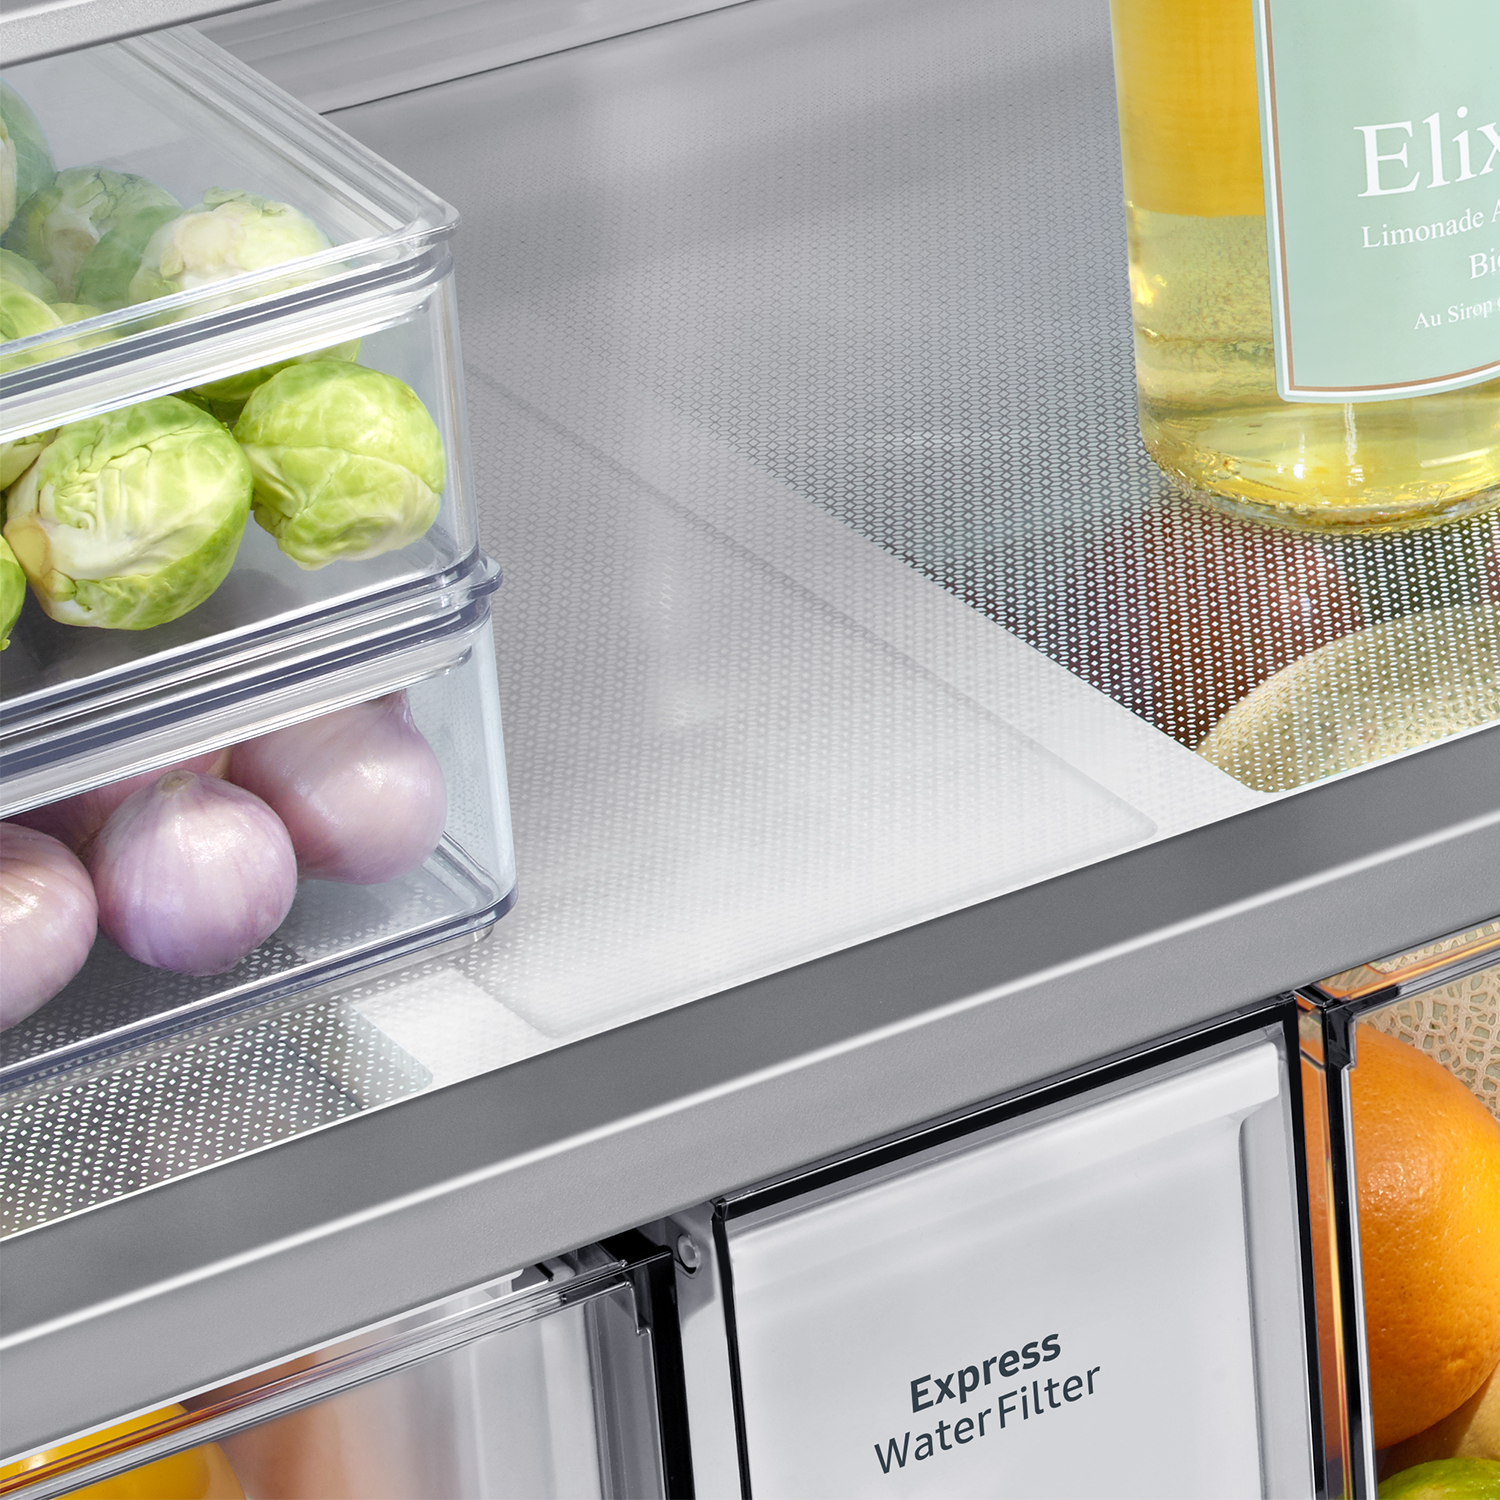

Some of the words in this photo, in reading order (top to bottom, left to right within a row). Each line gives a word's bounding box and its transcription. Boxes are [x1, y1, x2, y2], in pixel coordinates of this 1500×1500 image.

[1361, 207, 1485, 248] Limonade
[1413, 310, 1443, 330] Au
[1447, 296, 1494, 325] Sirop
[910, 1333, 1061, 1413] Express
